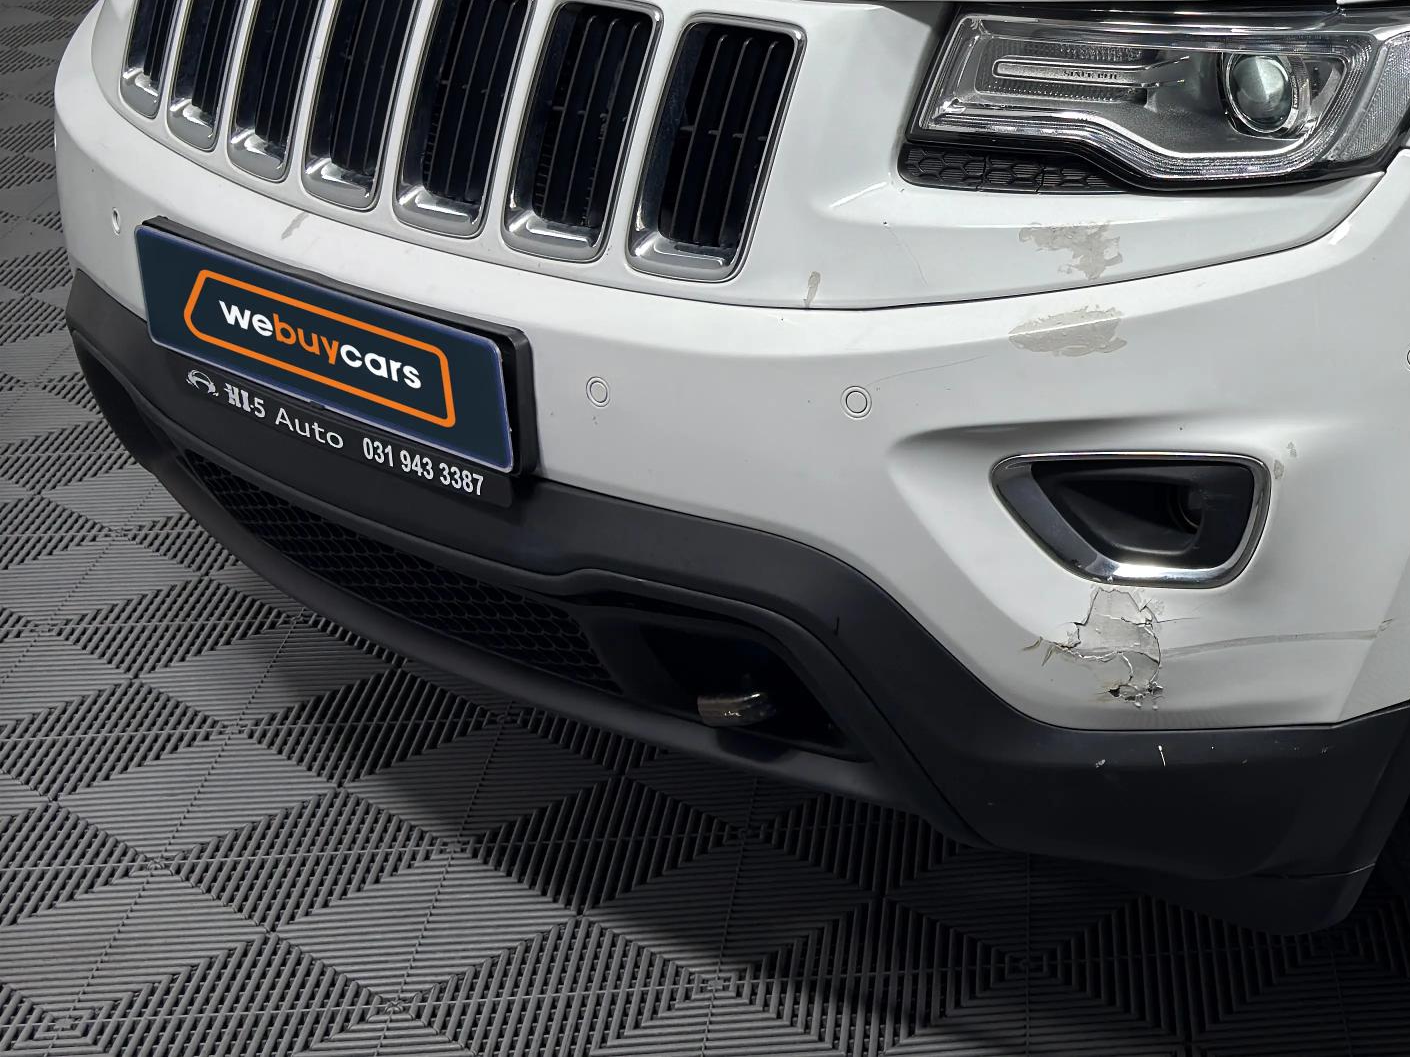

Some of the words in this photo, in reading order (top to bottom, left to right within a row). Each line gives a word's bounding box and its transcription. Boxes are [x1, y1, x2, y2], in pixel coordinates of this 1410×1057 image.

[218, 300, 422, 389] webuycars
[274, 407, 344, 449] Auto
[362, 437, 394, 468] 031
[400, 449, 434, 480] 943
[439, 462, 484, 496] 3387
